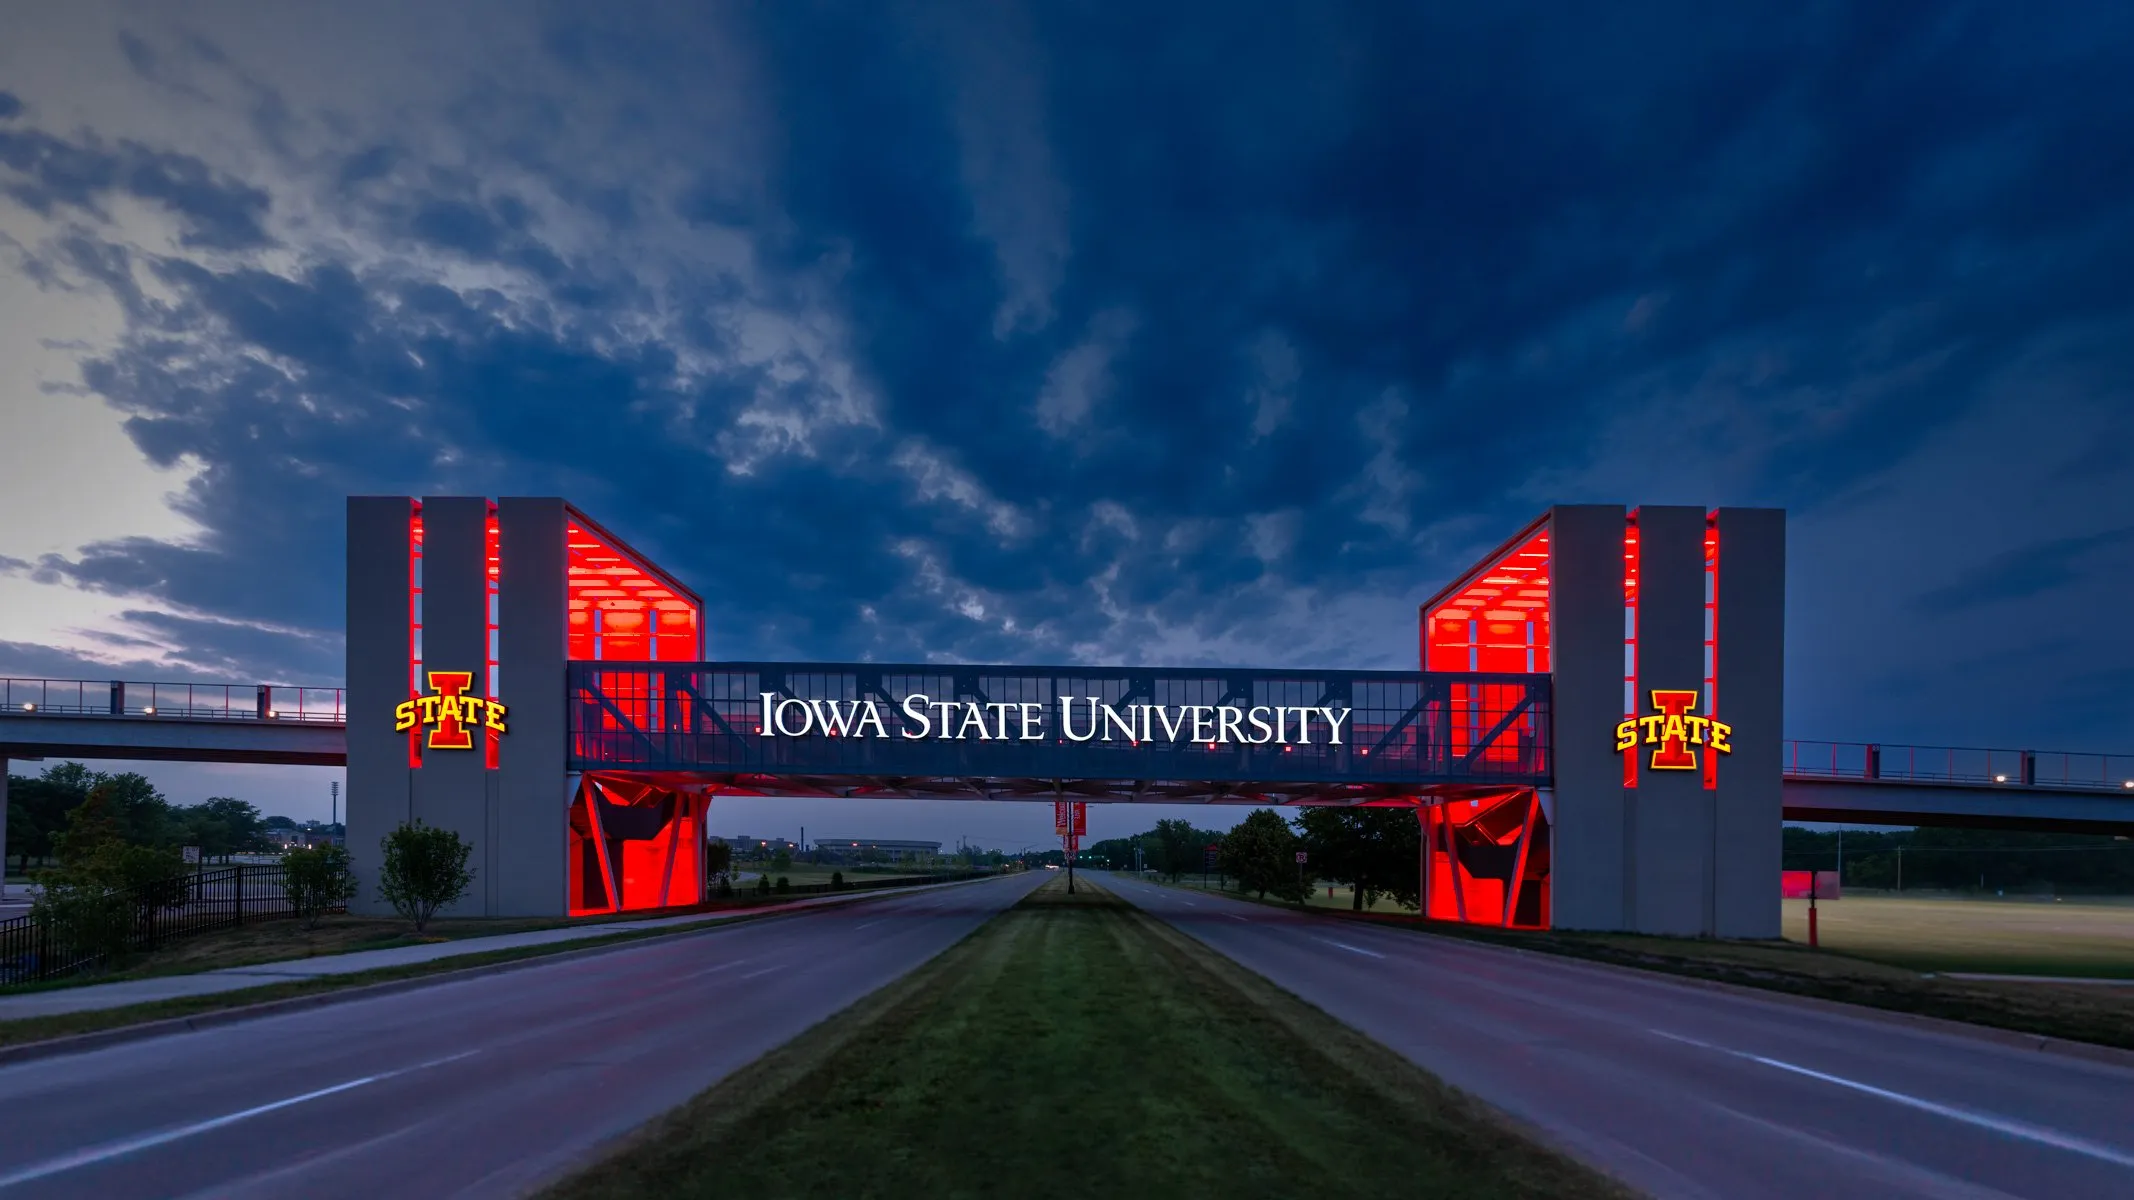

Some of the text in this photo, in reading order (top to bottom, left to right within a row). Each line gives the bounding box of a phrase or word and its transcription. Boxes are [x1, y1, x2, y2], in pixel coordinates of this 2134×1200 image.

[395, 695, 506, 732] STATE
[759, 692, 1352, 744] IOWA STATE UNIVERSITY
[1616, 714, 1732, 753] STATE
